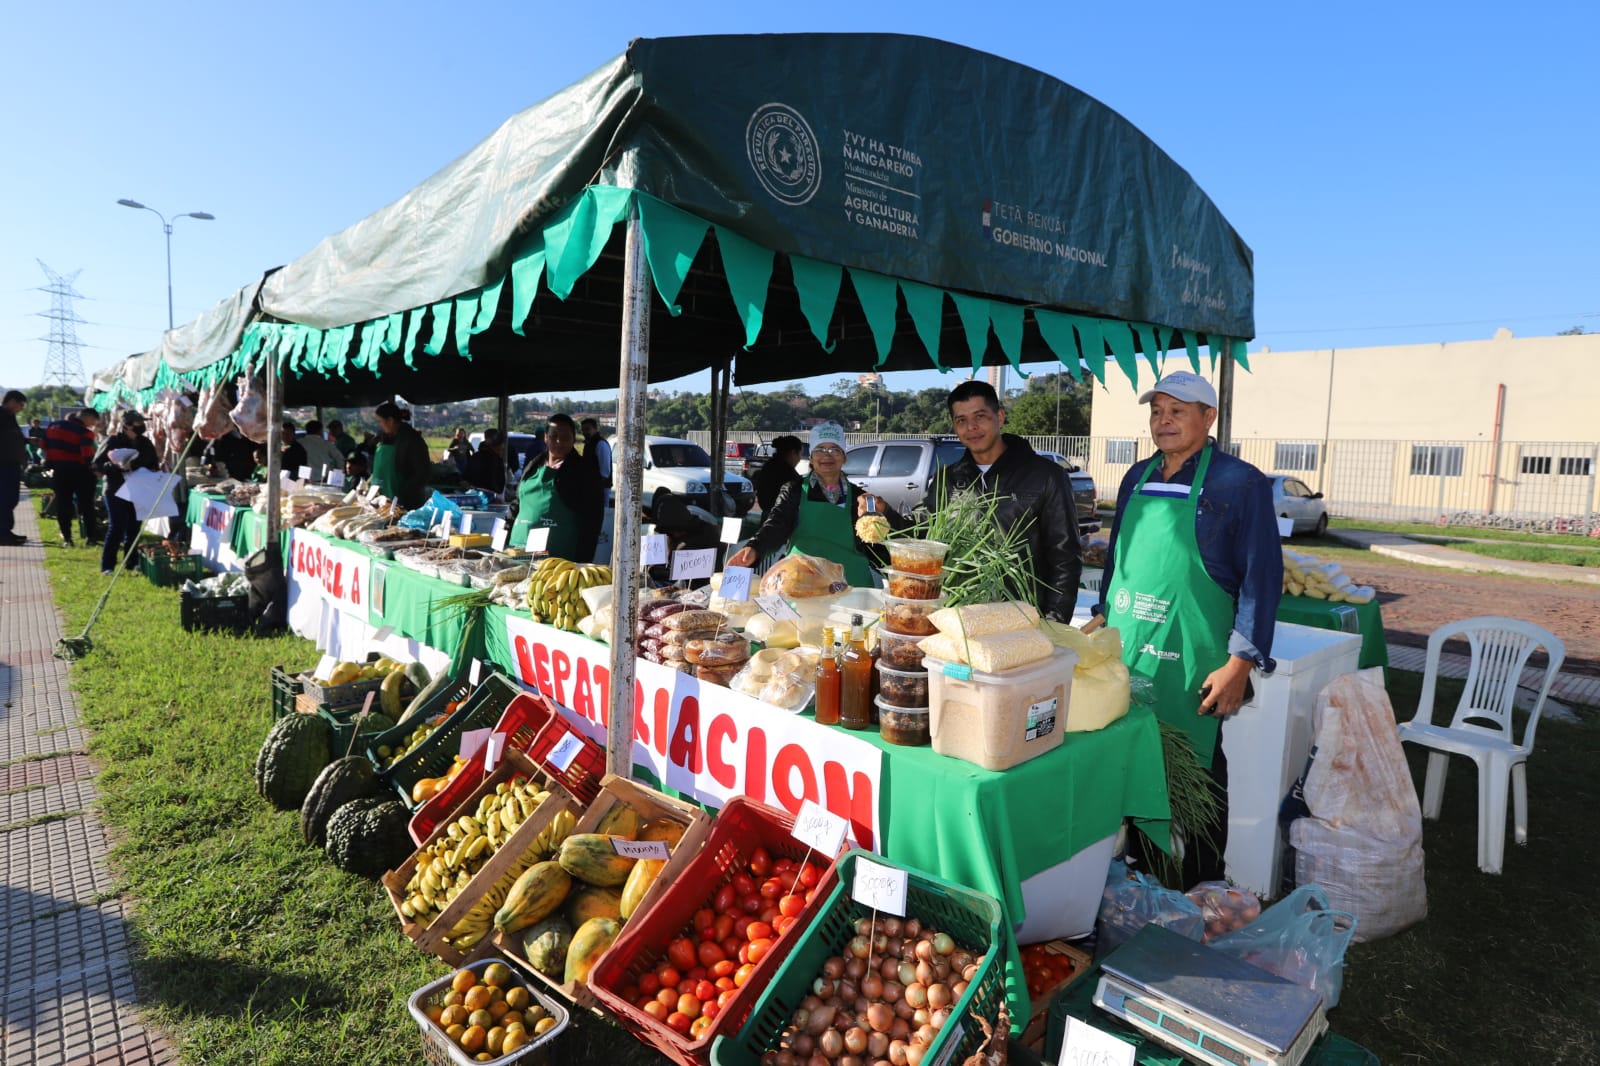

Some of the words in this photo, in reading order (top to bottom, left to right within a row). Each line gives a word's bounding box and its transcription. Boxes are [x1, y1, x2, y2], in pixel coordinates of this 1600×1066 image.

[777, 115, 793, 127] DEL
[795, 123, 815, 184] PARAGUAY
[843, 129, 866, 148] YVY
[869, 138, 886, 155] HA
[888, 145, 923, 168] TYMBA
[843, 143, 914, 177] ÑANGAREKO
[844, 195, 920, 226] AGRICULTURA
[879, 192, 888, 202] de
[845, 210, 852, 222] Y
[992, 227, 1053, 255] GOBIERNO
[1055, 242, 1108, 268] NACIONAL
